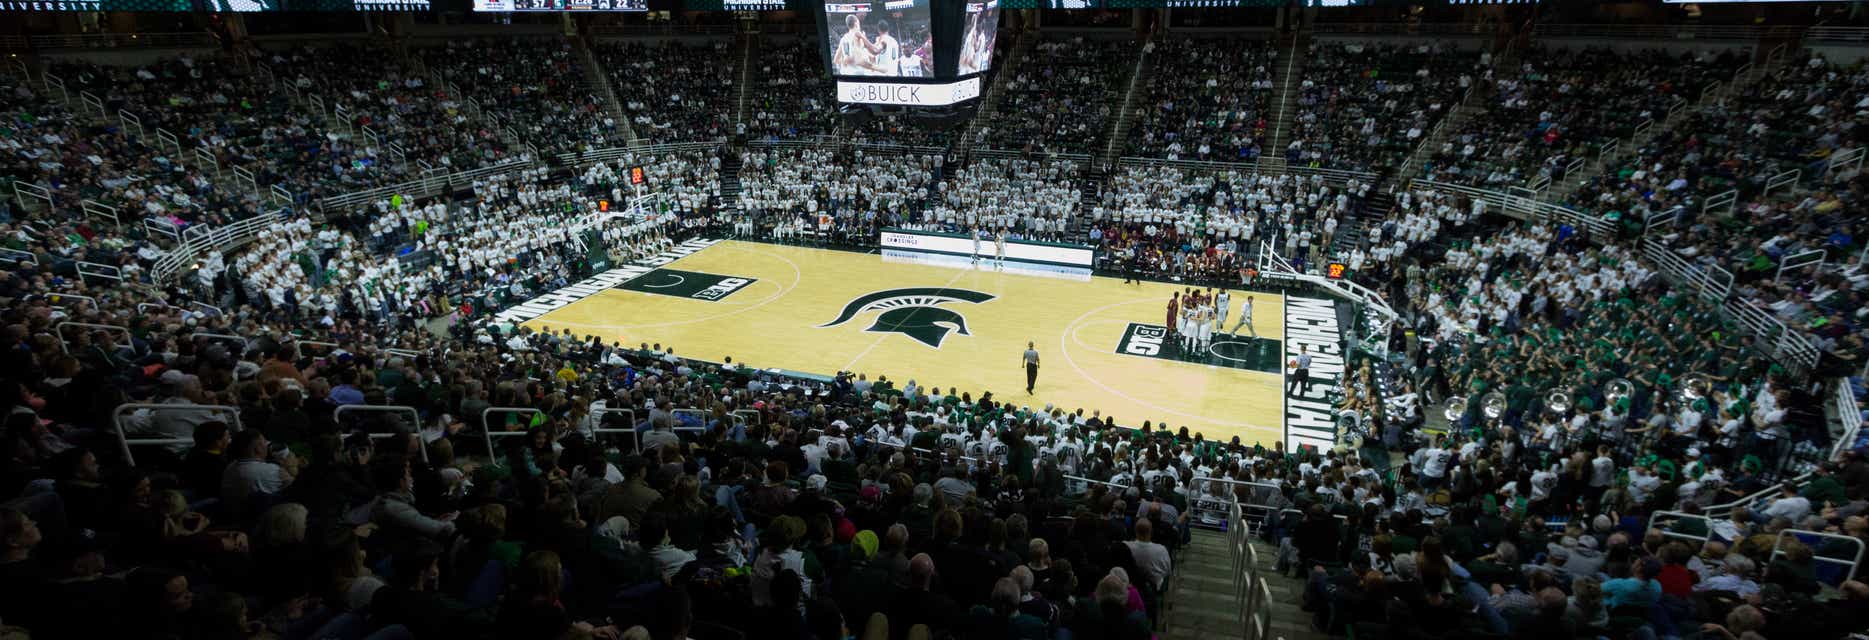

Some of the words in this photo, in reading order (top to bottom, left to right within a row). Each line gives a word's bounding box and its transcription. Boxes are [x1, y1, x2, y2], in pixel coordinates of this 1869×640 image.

[0, 2, 100, 10] NIVERSITY
[868, 85, 920, 102] BUICK
[495, 263, 655, 324] MICHIGAN
